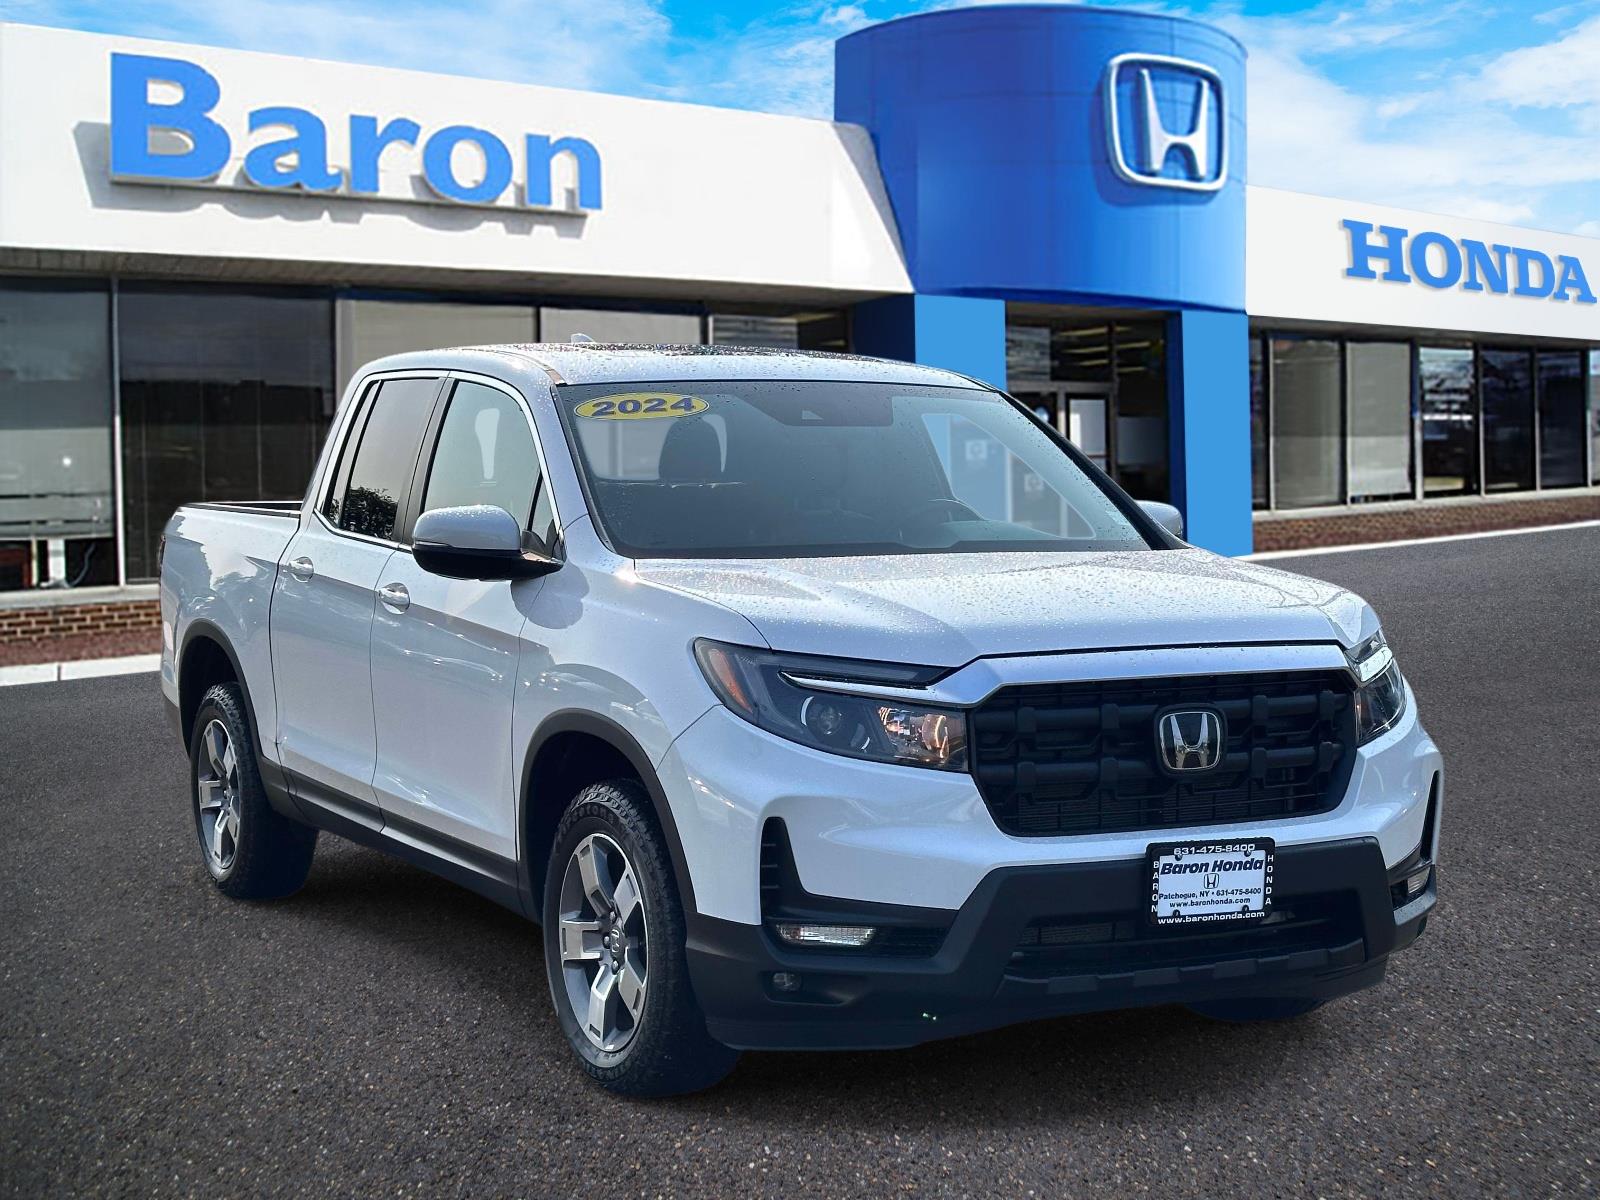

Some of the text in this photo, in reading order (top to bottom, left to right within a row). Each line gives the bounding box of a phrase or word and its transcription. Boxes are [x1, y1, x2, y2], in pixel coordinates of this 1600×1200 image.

[110, 51, 602, 210] Baron
[1341, 218, 1598, 303] HONDA
[592, 397, 697, 416] 2024
[1173, 843, 1256, 855] 631-475-8400
[1160, 858, 1264, 875] Baron Honda
[1151, 861, 1159, 913] BARON
[1265, 855, 1274, 905] HONDA
[1216, 887, 1262, 896] 631-475-8400
[1169, 897, 1251, 908] www.baronhonda.com
[1157, 910, 1265, 924] www.baronhonda.com
